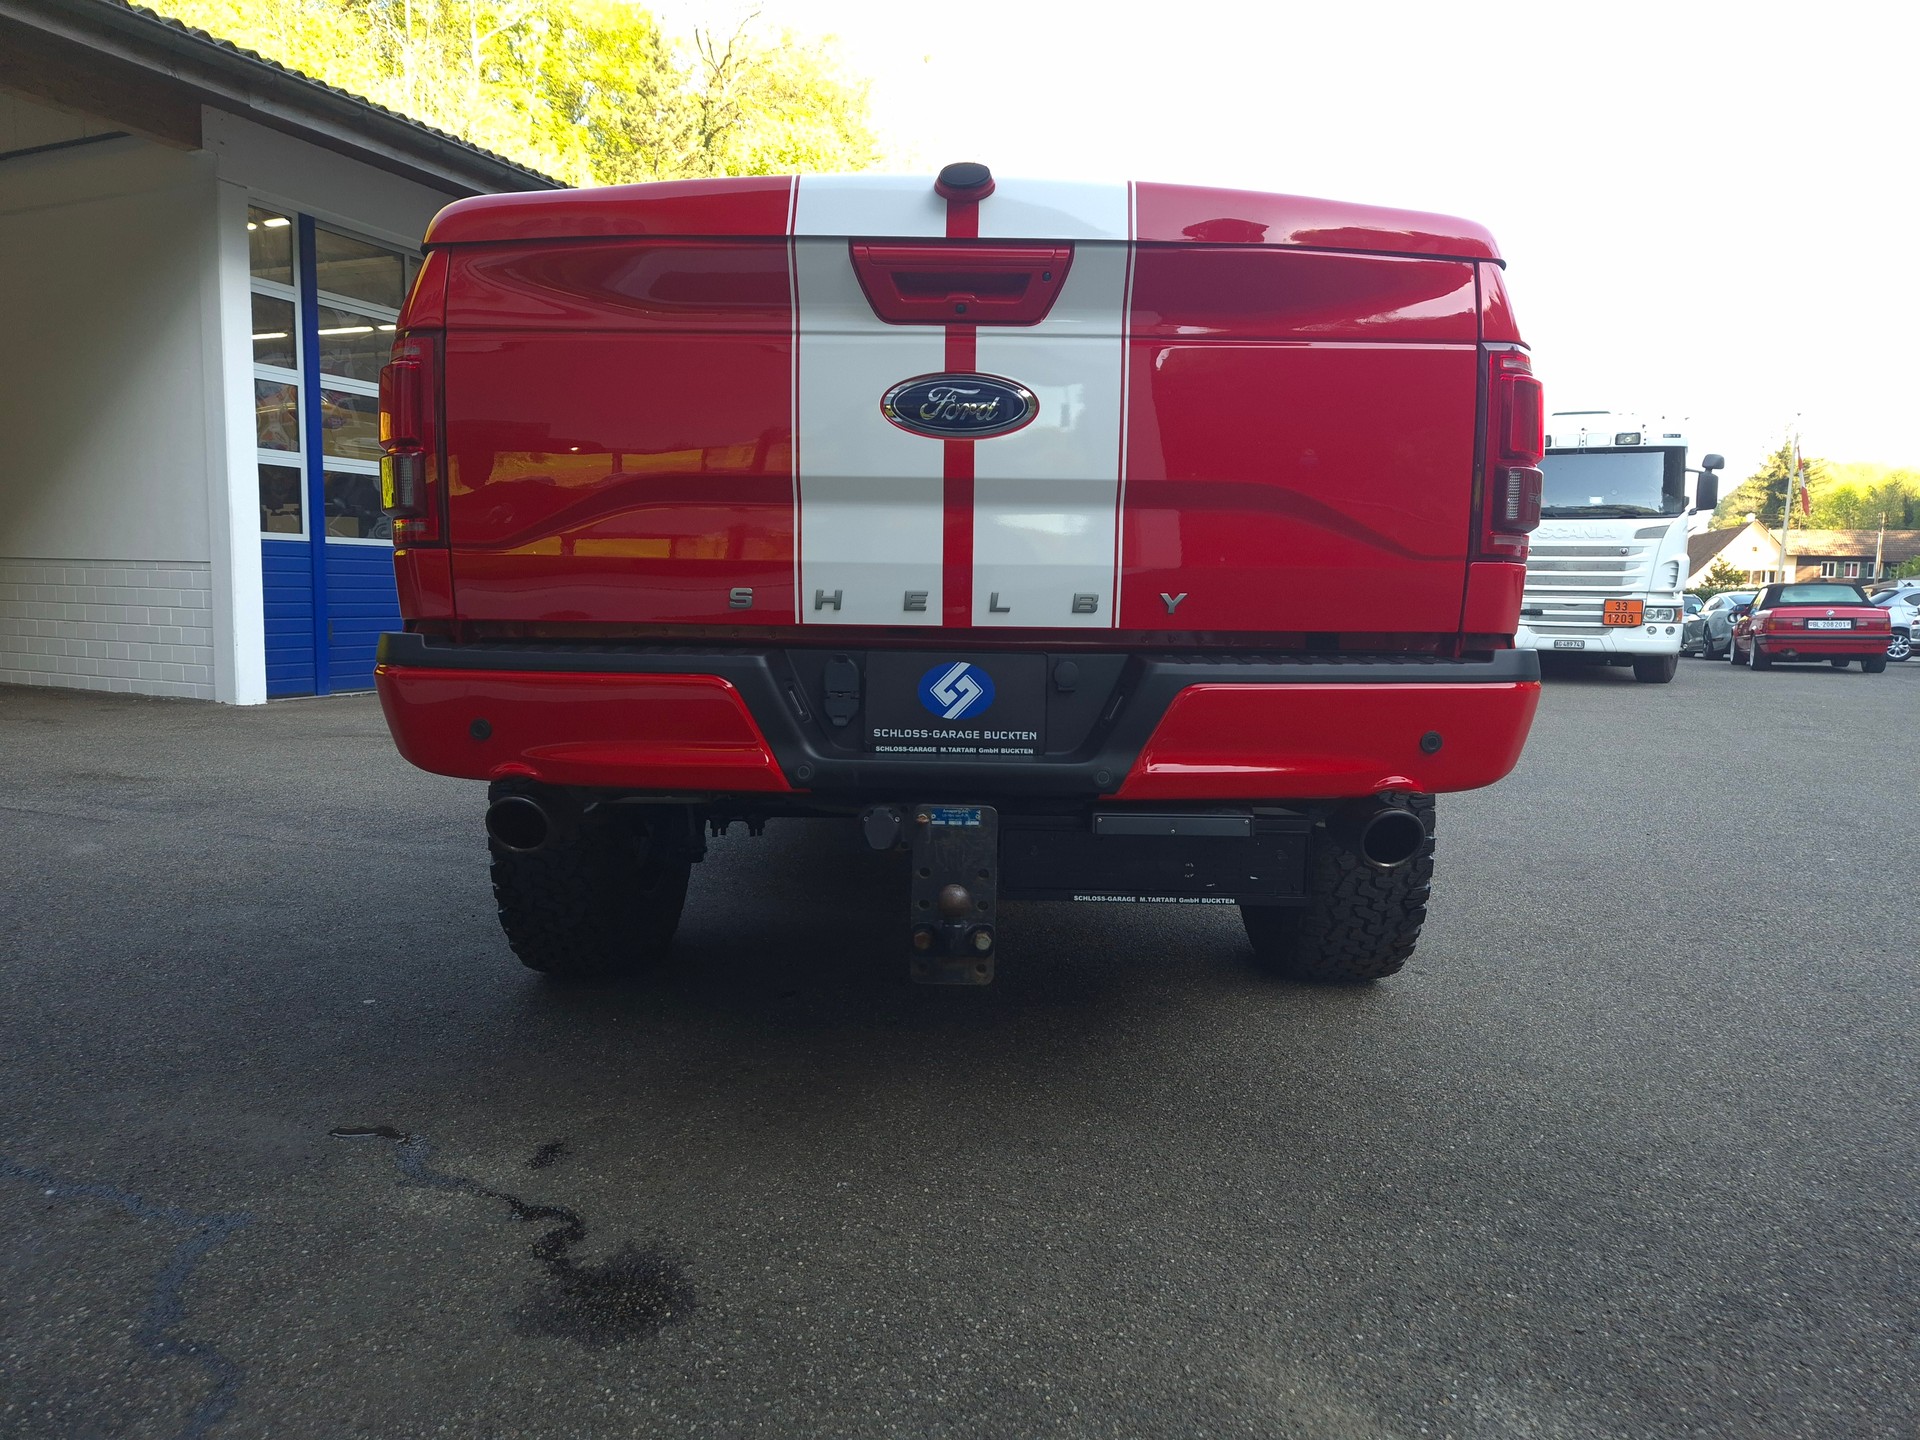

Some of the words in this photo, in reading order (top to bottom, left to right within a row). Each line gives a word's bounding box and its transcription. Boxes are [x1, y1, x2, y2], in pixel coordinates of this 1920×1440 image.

[919, 386, 1000, 421] Ford
[1536, 527, 1617, 540] SCANIA
[729, 587, 1188, 614] SHELBY
[1615, 601, 1628, 611] 33
[1607, 614, 1634, 623] 1203
[873, 728, 980, 739] SCHLOSS-GARAGE
[984, 731, 1037, 740] BUCKTEN
[875, 745, 937, 753] SCHLOSS-GARAGE
